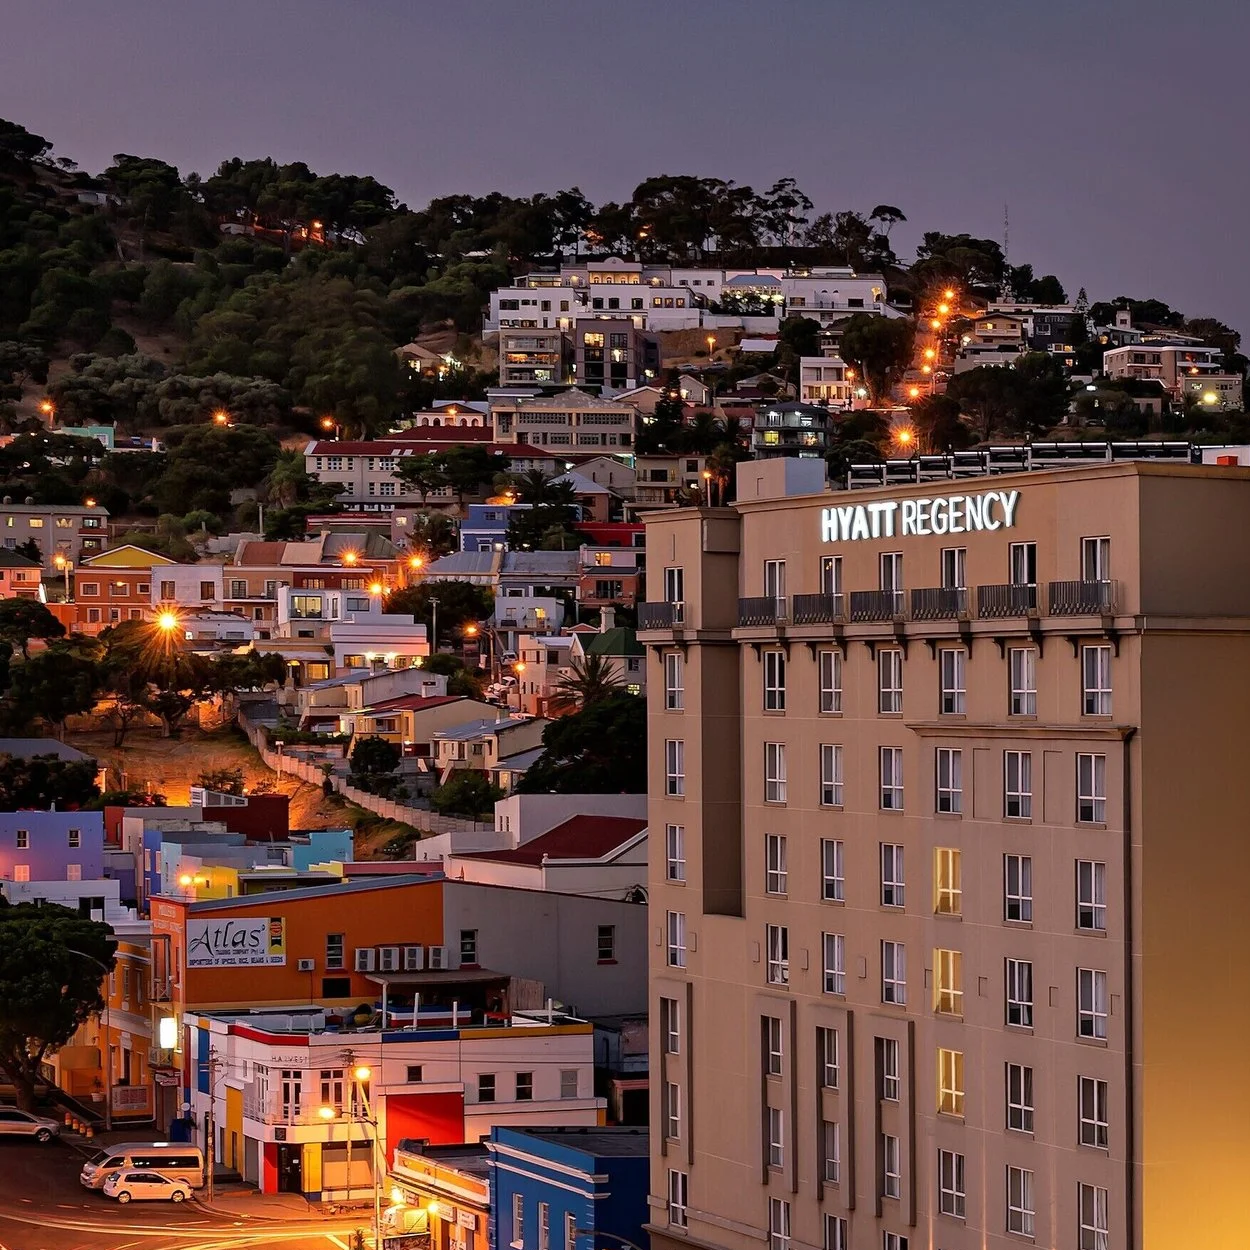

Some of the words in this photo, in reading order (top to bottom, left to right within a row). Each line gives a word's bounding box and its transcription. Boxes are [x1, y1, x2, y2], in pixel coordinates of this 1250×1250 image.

[821, 502, 898, 543] HYATT
[901, 490, 1020, 536] REGENCY
[190, 921, 262, 958] Atlas
